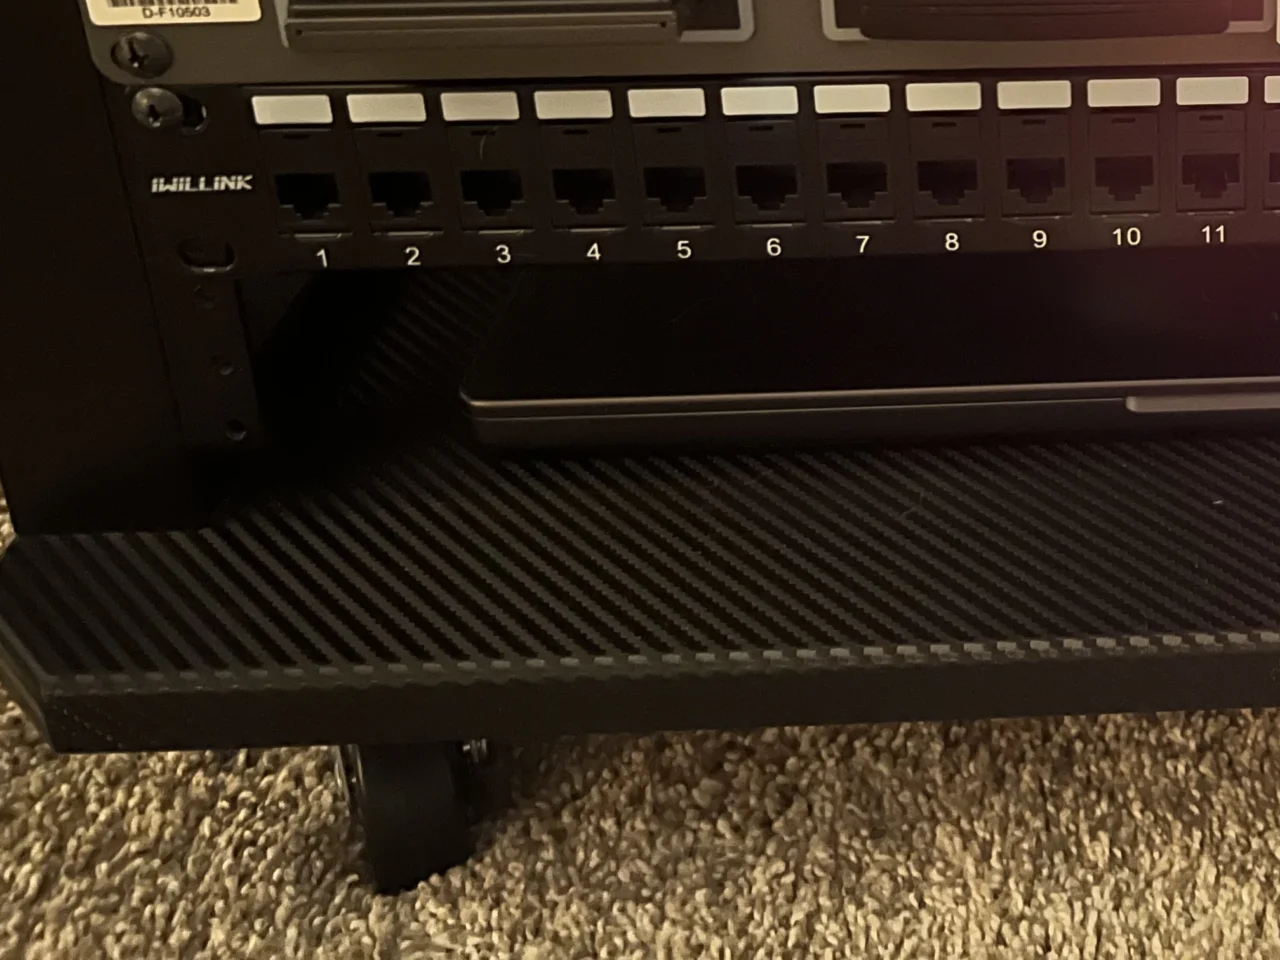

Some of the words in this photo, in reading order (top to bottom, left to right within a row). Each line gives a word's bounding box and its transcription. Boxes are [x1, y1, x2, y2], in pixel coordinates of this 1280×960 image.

[143, 7, 210, 18] D-F10503
[315, 248, 328, 268] 1
[404, 246, 421, 266] 2
[495, 244, 512, 264] 3
[586, 242, 601, 262] 4
[676, 240, 692, 260] 5
[766, 238, 782, 257] 6
[855, 234, 871, 254] 7
[944, 232, 960, 251] 8
[1032, 230, 1048, 249] 9
[1112, 228, 1142, 246] 10
[1200, 225, 1226, 244] 11
